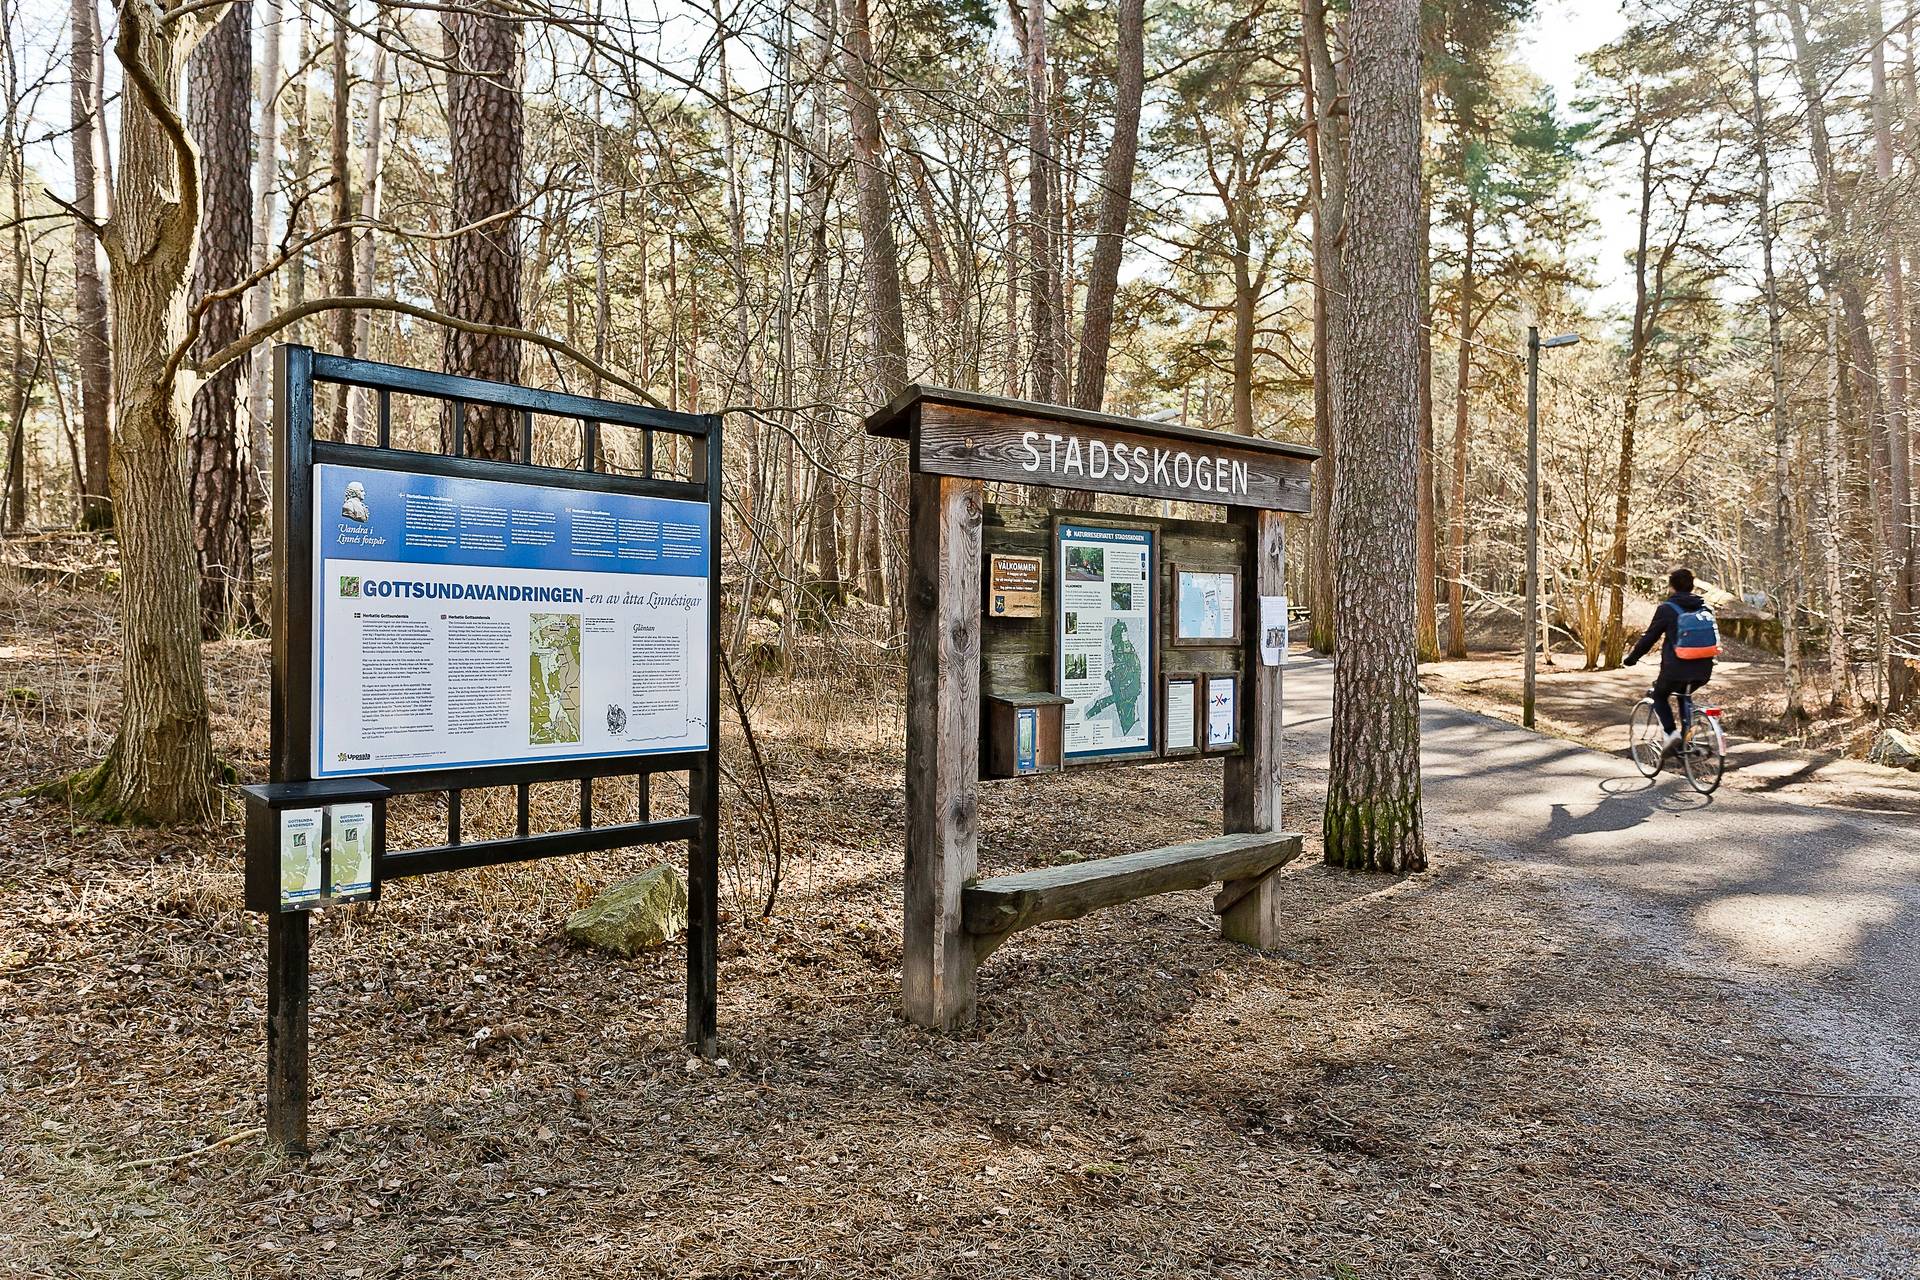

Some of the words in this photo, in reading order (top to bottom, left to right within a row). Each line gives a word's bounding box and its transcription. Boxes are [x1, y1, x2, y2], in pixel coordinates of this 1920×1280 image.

[1021, 431, 1248, 496] STADSSKOGEN
[337, 524, 368, 534] Vandra
[369, 526, 374, 535] i
[336, 533, 361, 545] Linnés
[360, 535, 387, 547] fotspår
[1073, 531, 1114, 540] NATURRESERVATET
[1114, 533, 1145, 542] STADSSKOGEN
[997, 560, 1037, 572] VÄLKOMMEN
[363, 580, 583, 603] GOTTSUNDAVANDRINGEN
[605, 593, 621, 605] av
[623, 590, 645, 607] åtta
[646, 592, 702, 611] Linnéstigar
[632, 623, 656, 634] Gläntan
